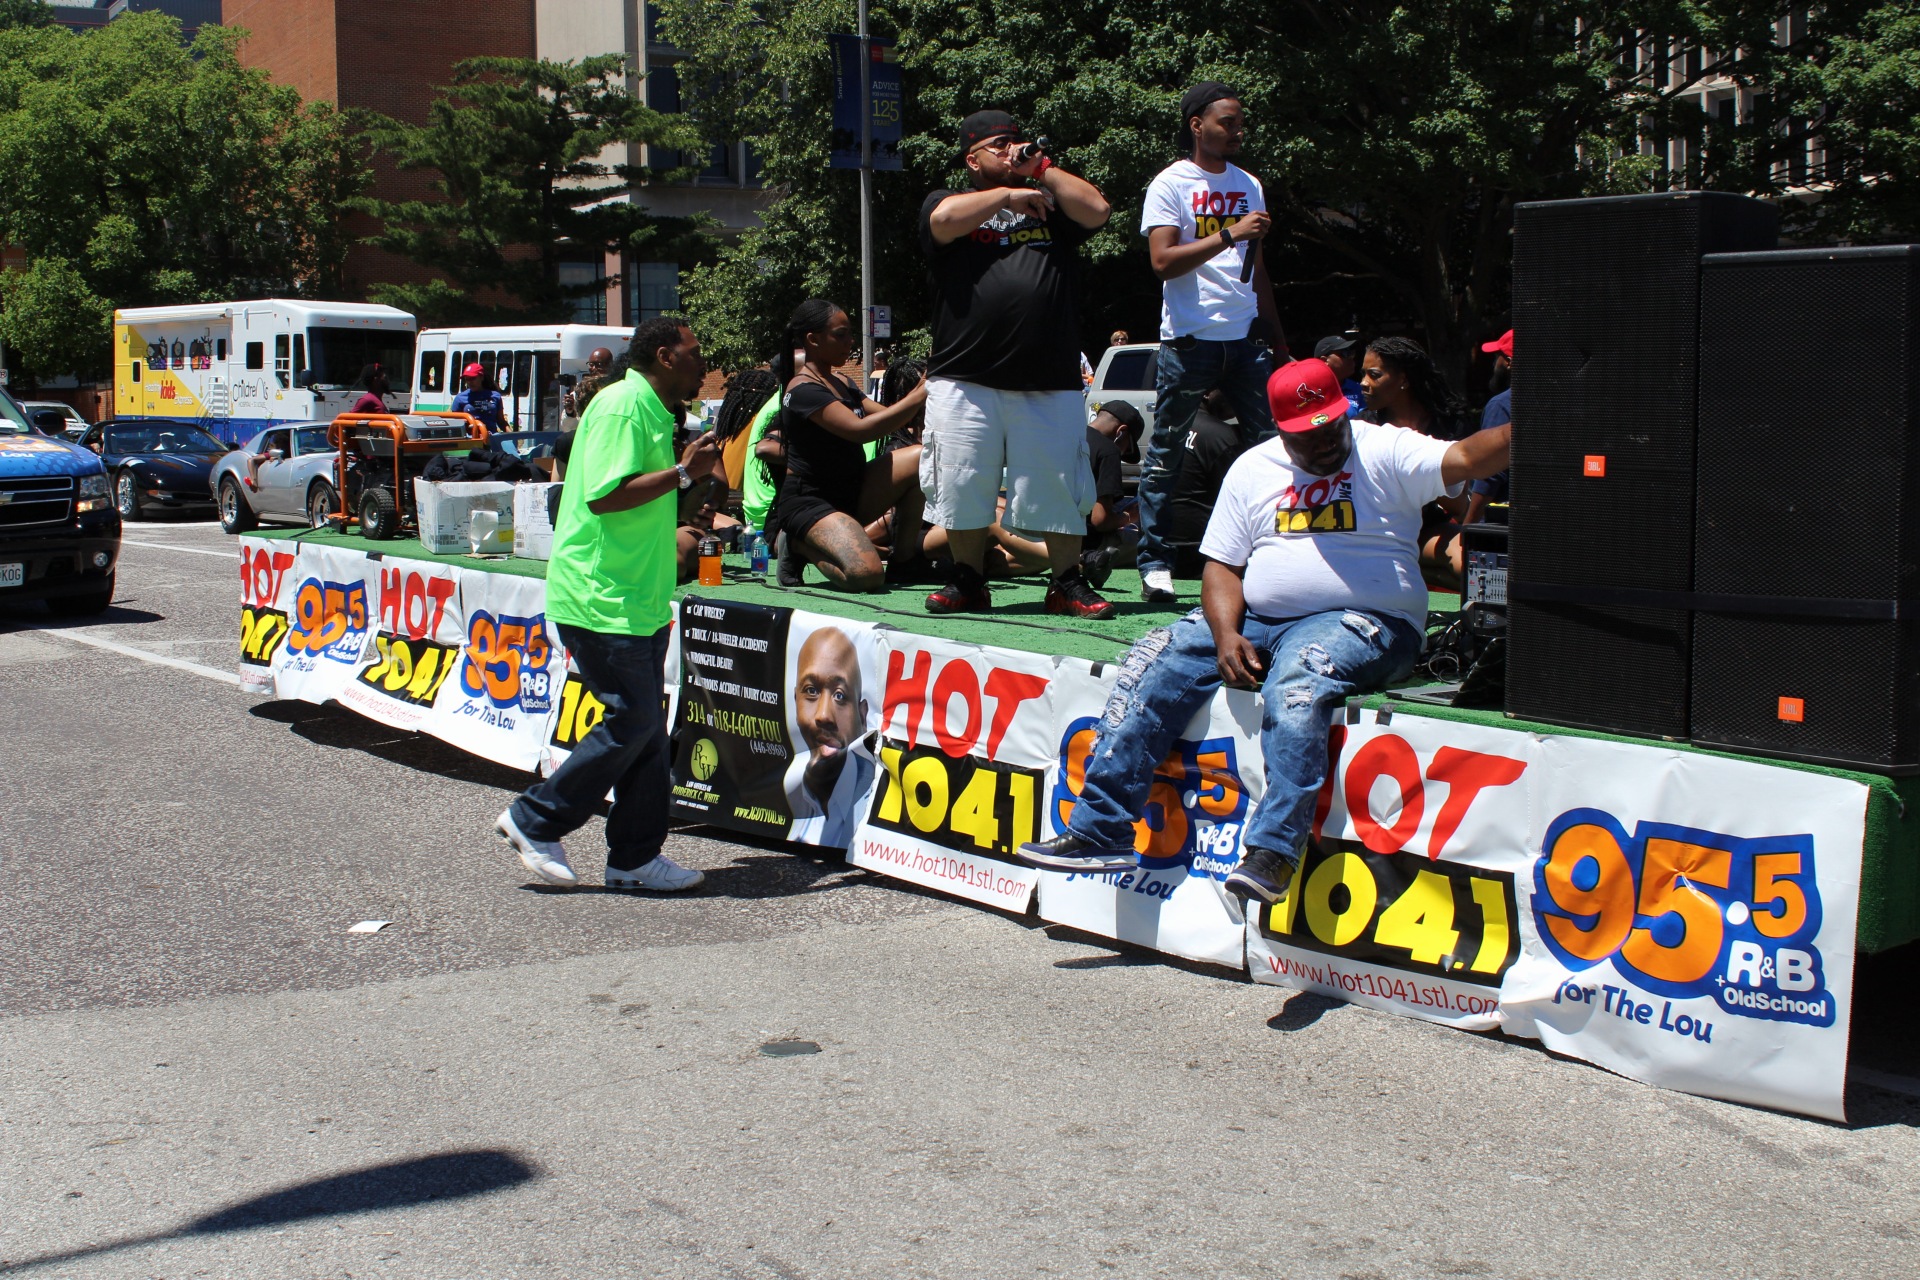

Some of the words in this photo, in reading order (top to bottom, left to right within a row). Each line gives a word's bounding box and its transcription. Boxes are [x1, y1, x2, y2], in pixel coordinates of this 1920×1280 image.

[872, 80, 899, 91] ADVICE
[872, 99, 900, 122] 125
[1192, 190, 1246, 217] HOT
[160, 380, 175, 399] kids
[1587, 461, 1601, 472] JBL
[289, 584, 364, 651] 95.5
[380, 568, 456, 641] HOT
[336, 632, 366, 651] R&B
[692, 627, 707, 641] TRUCK
[738, 636, 768, 653] ACCIDENTS?
[690, 651, 716, 667] WRONGFUL
[519, 672, 548, 696] R&B
[719, 681, 740, 697] ACCIDENT
[453, 700, 479, 714] for
[478, 706, 496, 726] The
[497, 711, 516, 730] Lou
[880, 650, 1050, 762] HOT
[1782, 704, 1798, 715] JBL
[687, 700, 706, 725] 314
[713, 708, 782, 743] 618-I-GOT-YOU
[750, 739, 787, 760] (446-8968)
[672, 785, 699, 799] RODERICK
[703, 792, 720, 805] WHITE
[878, 746, 1034, 854] 104.1
[1194, 818, 1239, 856] R&B
[864, 838, 1026, 898] www.hot1041stl.com
[1134, 872, 1178, 900] Lou
[1269, 848, 1510, 975] 104.1
[1543, 822, 1807, 984] 95.5
[1726, 940, 1816, 992] R&B
[1269, 956, 1500, 1018] www.hot1041stl.com
[1552, 976, 1597, 1005] for
[1602, 986, 1652, 1025] The
[1658, 1001, 1714, 1044] Lou
[1723, 986, 1827, 1018] OldSchool
